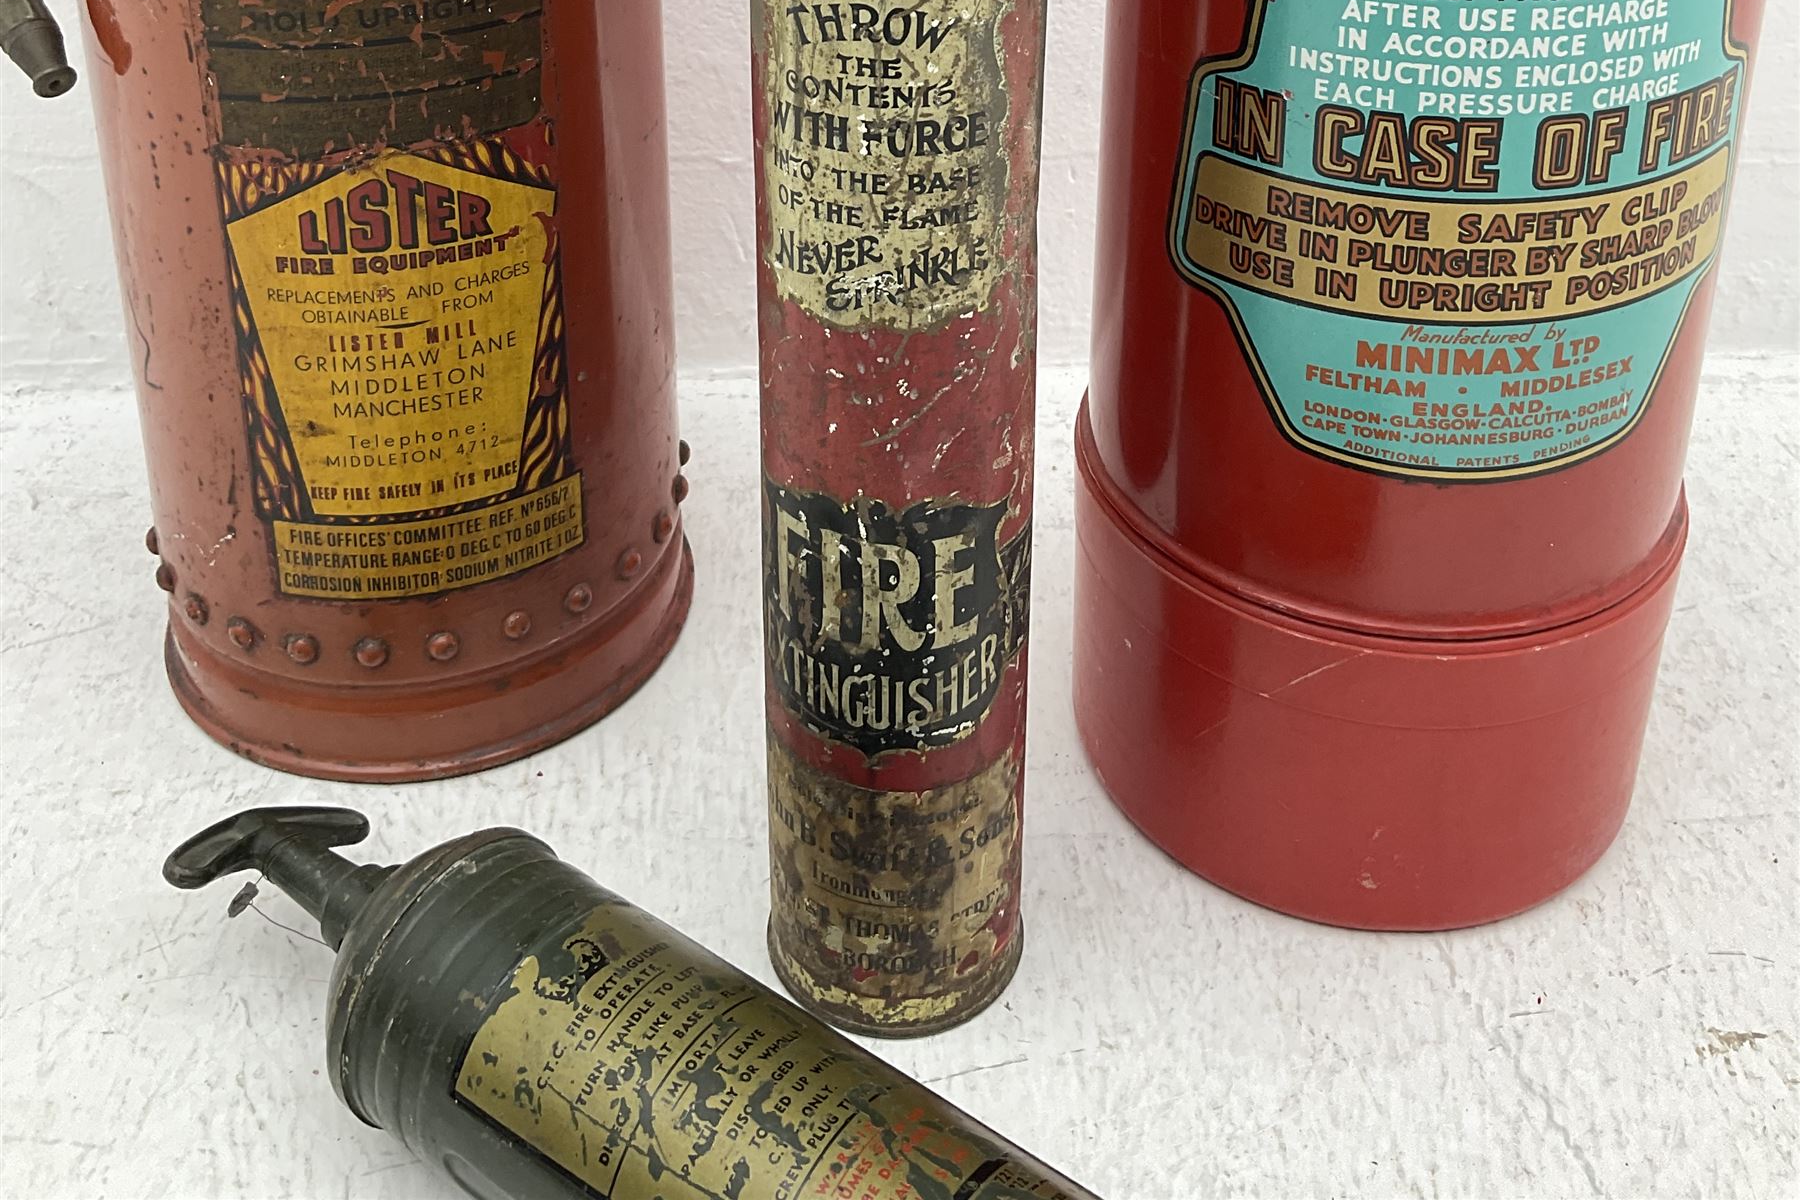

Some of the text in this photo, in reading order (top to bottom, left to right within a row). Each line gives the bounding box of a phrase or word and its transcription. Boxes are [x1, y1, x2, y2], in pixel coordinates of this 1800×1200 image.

[786, 3, 956, 54] THROW
[1341, 0, 1442, 30] AFTER
[1458, 7, 1517, 32] USE
[1337, 21, 1670, 61] IN ACCORDANCE WITH
[836, 53, 904, 81] THE
[1288, 39, 1702, 90] INSTRUCTIONS ENCLOSED WITH
[786, 68, 957, 109] CONTENTS
[1314, 73, 1679, 116] EACH PRESSURE CHARGE
[774, 99, 990, 158] WITH FORCE
[1213, 62, 1740, 192] IN CASE OF FIRE
[831, 167, 888, 196] THE
[907, 164, 983, 196] BASE
[298, 168, 494, 254] LISTER
[778, 183, 980, 231] OF THE FLAME
[1267, 180, 1689, 244] REMOVE SAFETY CLIP
[776, 227, 884, 276] NEVER
[1194, 184, 1725, 279] DRIVE IN PLUNGER BY SHARP BLOW
[274, 237, 509, 276] FIRE EQUIPMENT
[1228, 236, 1697, 312] USE IN UPRIGHT POSITION
[266, 261, 531, 305] REPLACEMENTS AND CHARGES
[301, 291, 494, 325] OBTAINABLE FROM
[294, 329, 518, 374] GRIMSHAW LANE
[329, 318, 477, 353] LISTER MILL
[1400, 322, 1569, 346] Manufactured by
[1305, 354, 1635, 399] FELTHAM MIDDLESEX
[1356, 339, 1543, 377] MINIMAX
[330, 365, 487, 397] MIDDLETON
[332, 385, 484, 420] MANCHESTER
[1304, 390, 1634, 431] LONDON GLASGOW CALCUTTA BOMBAY
[348, 419, 488, 450] Telephone:
[1301, 406, 1629, 447] CAPE TOWN JOHANNESBURG DURBAN
[326, 434, 501, 469] MIDDLETON 4712
[1343, 434, 1591, 468] ADDITIONAL PATENTS PENDING
[310, 460, 520, 501] KEEP FIRE SAFELY IN ITS PLACE
[284, 549, 389, 570] TEMPERATURE
[505, 527, 522, 545] TO
[524, 522, 542, 541] 60
[289, 527, 323, 548] FIRE
[284, 573, 362, 593] CORROSION
[446, 560, 500, 585] SODIUM
[503, 540, 554, 571] NITRITE
[776, 502, 979, 652] FIRE
[600, 963, 662, 1020] OPERATE
[607, 998, 655, 1053] HANDLE
[728, 1028, 766, 1062] LEAVE
[574, 1058, 608, 1107] TURN
